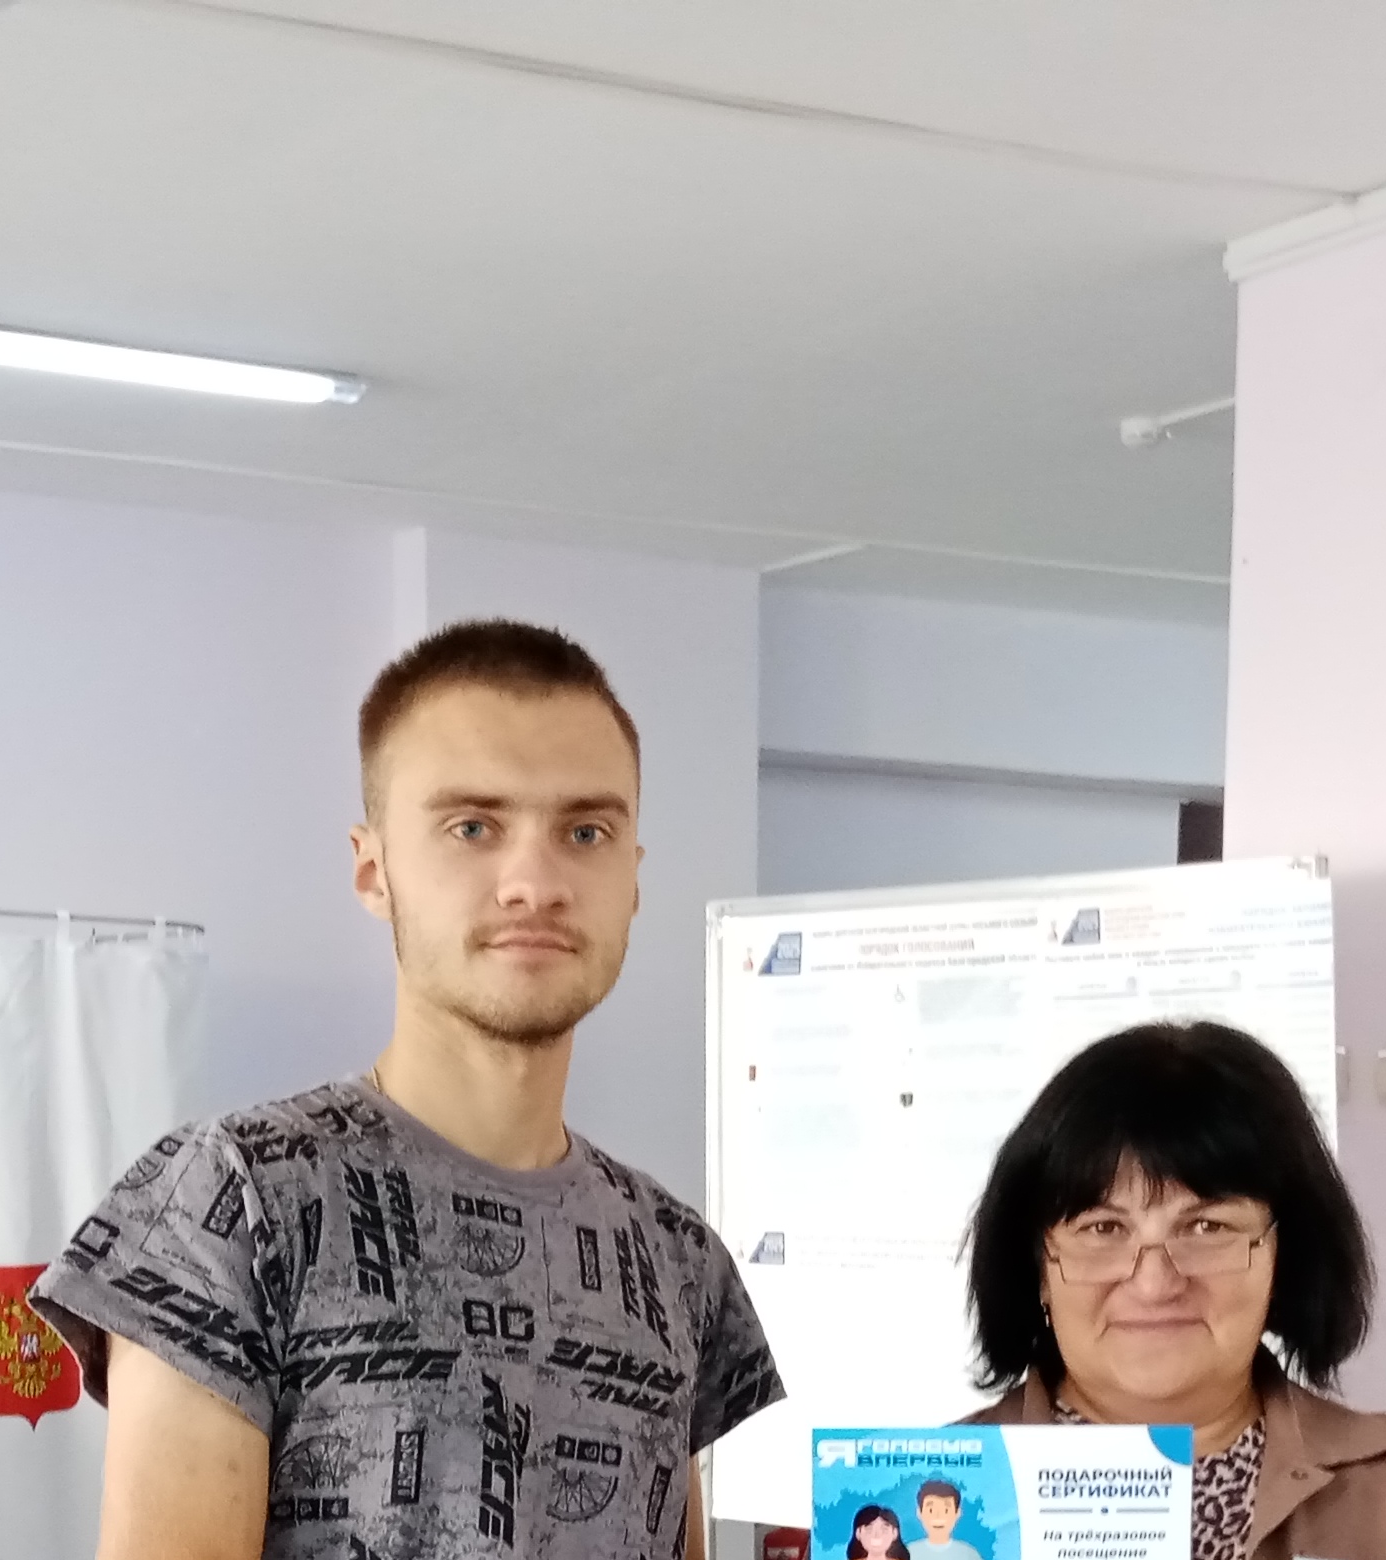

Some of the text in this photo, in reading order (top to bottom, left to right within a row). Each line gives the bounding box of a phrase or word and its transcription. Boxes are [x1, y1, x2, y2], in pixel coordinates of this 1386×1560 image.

[817, 1439, 856, 1468] Я
[858, 1454, 983, 1468] ВПЕРВЫЕ
[1038, 1466, 1173, 1483] ПОДАРОЧНЫЙ
[1038, 1484, 1173, 1499] СЕРТИФИКАТ
[1043, 1529, 1166, 1543] На трёхразовое
[1058, 1548, 1148, 1560] посещение
